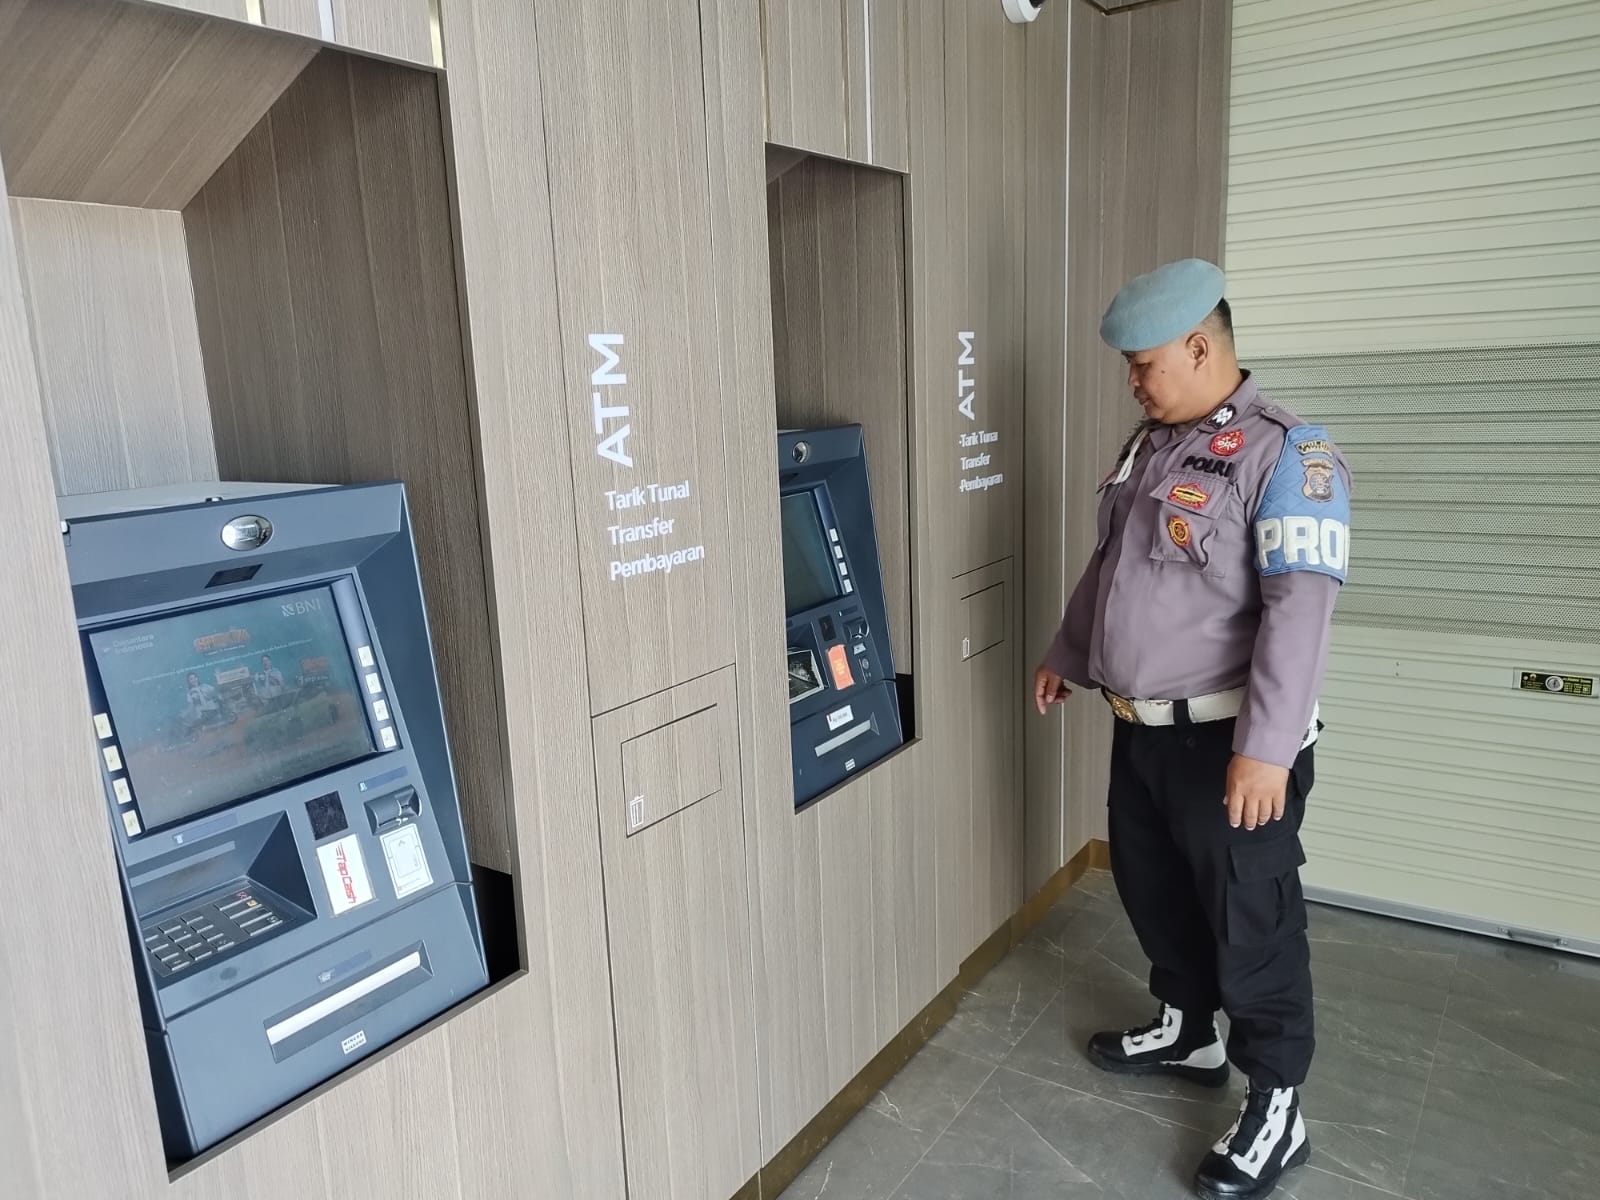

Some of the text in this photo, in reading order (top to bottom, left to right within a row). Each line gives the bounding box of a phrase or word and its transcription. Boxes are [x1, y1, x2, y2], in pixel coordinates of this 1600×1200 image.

[958, 331, 975, 420] ATM
[588, 333, 633, 468] ATM
[959, 432, 979, 447] Tarik
[960, 452, 991, 470] Transfer
[1181, 455, 1233, 477] POLRI
[604, 480, 690, 511] Tarik Tunai
[960, 473, 1003, 492] Pembayaran
[607, 517, 675, 546] Transfer
[1255, 515, 1350, 576] PRO
[610, 545, 705, 581] Pembayaran
[296, 598, 321, 615] BNI
